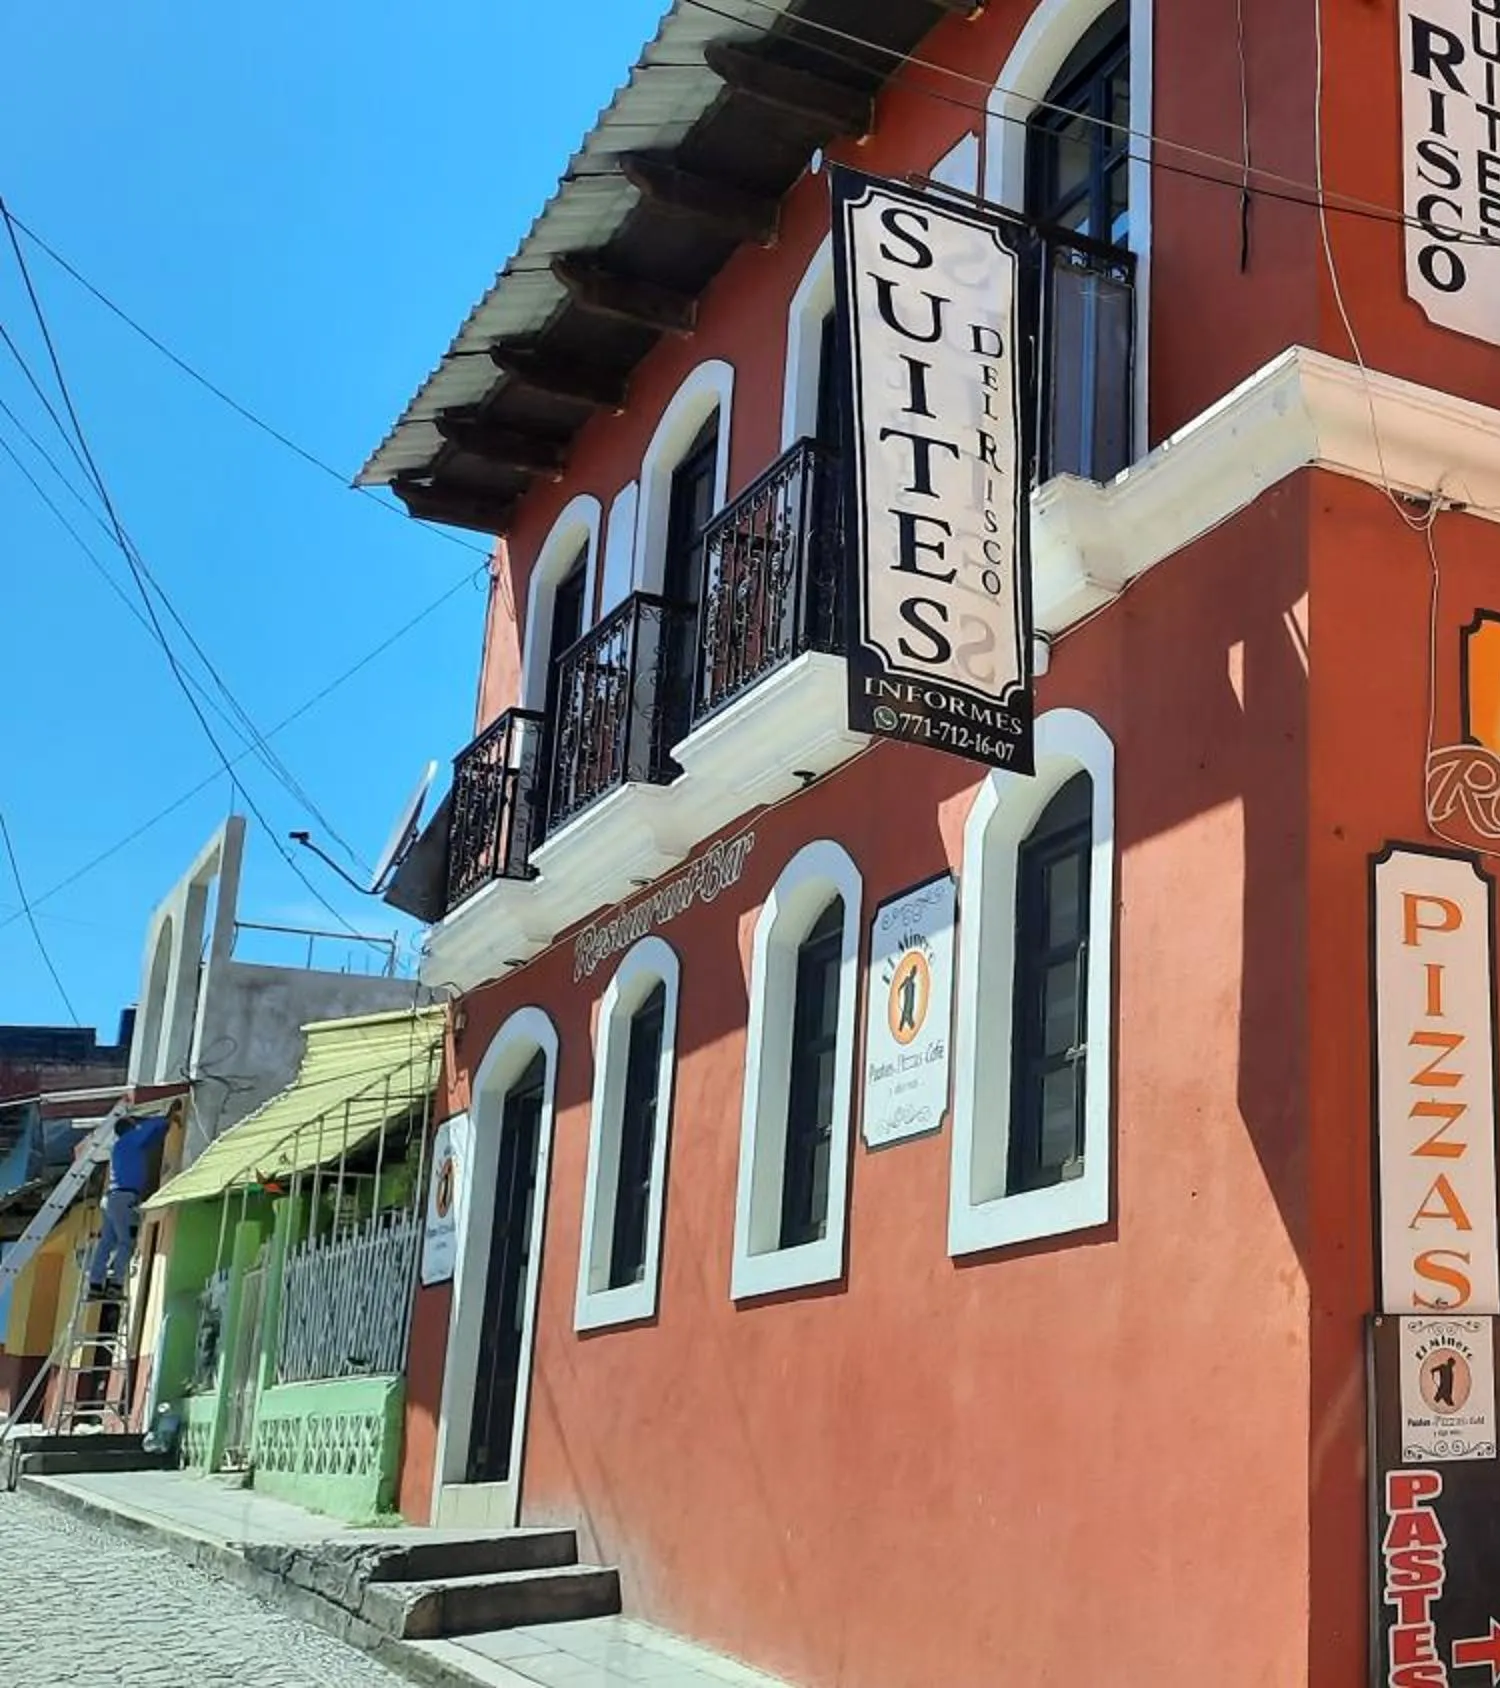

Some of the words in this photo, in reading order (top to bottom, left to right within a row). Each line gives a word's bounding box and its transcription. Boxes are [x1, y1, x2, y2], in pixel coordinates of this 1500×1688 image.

[1408, 13, 1470, 293] RISCO
[867, 206, 958, 666] SUITES
[865, 677, 1023, 735] INFORMES
[899, 711, 1015, 762] 771-712-16-07
[1400, 892, 1473, 1311] PIZZAS
[1382, 1469, 1449, 1688] PASTES
